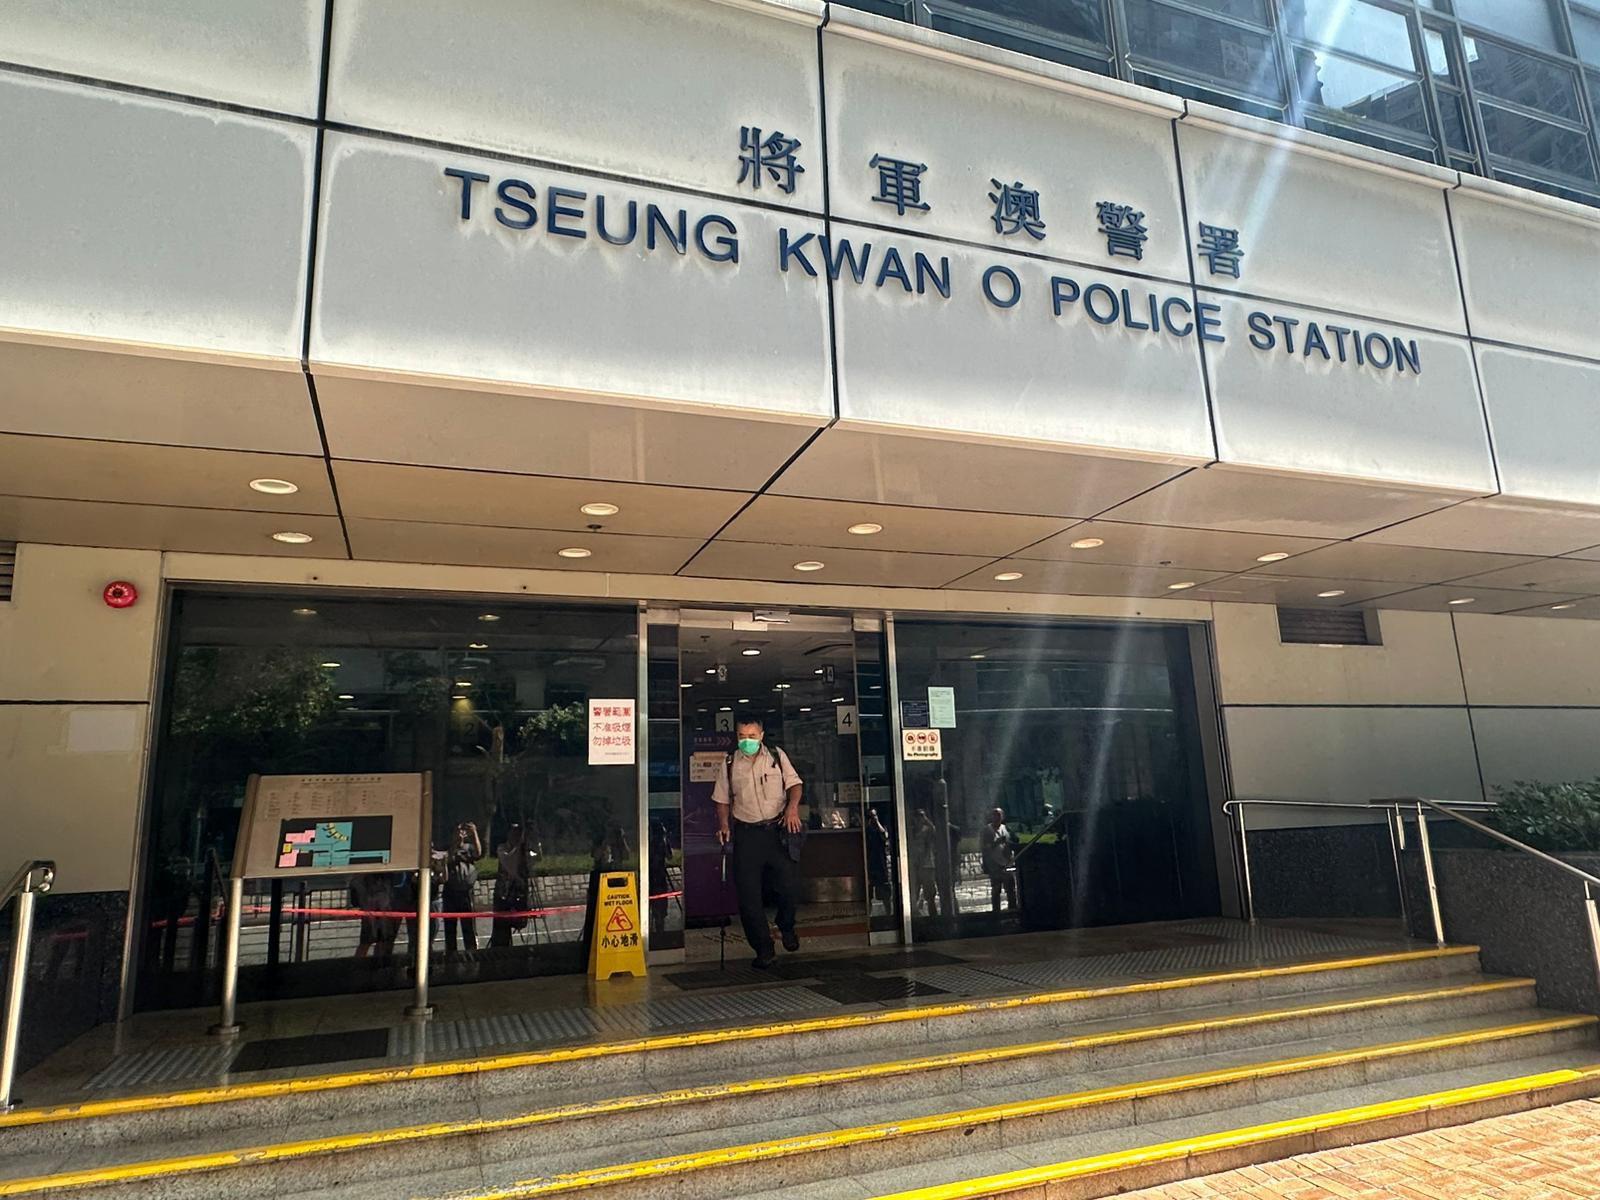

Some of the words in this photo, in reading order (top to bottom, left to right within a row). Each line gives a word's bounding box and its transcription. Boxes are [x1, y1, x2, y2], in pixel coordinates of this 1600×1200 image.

[737, 126, 1245, 280] 將軍澳警署
[444, 166, 739, 264] TSEUNG
[779, 227, 951, 299] KWAN
[982, 264, 1021, 309] O
[1051, 275, 1226, 343] POLICE
[1248, 311, 1421, 375] STATION
[720, 718, 729, 732] 3
[842, 712, 852, 727] 4
[601, 933, 638, 948] 小心地滑
